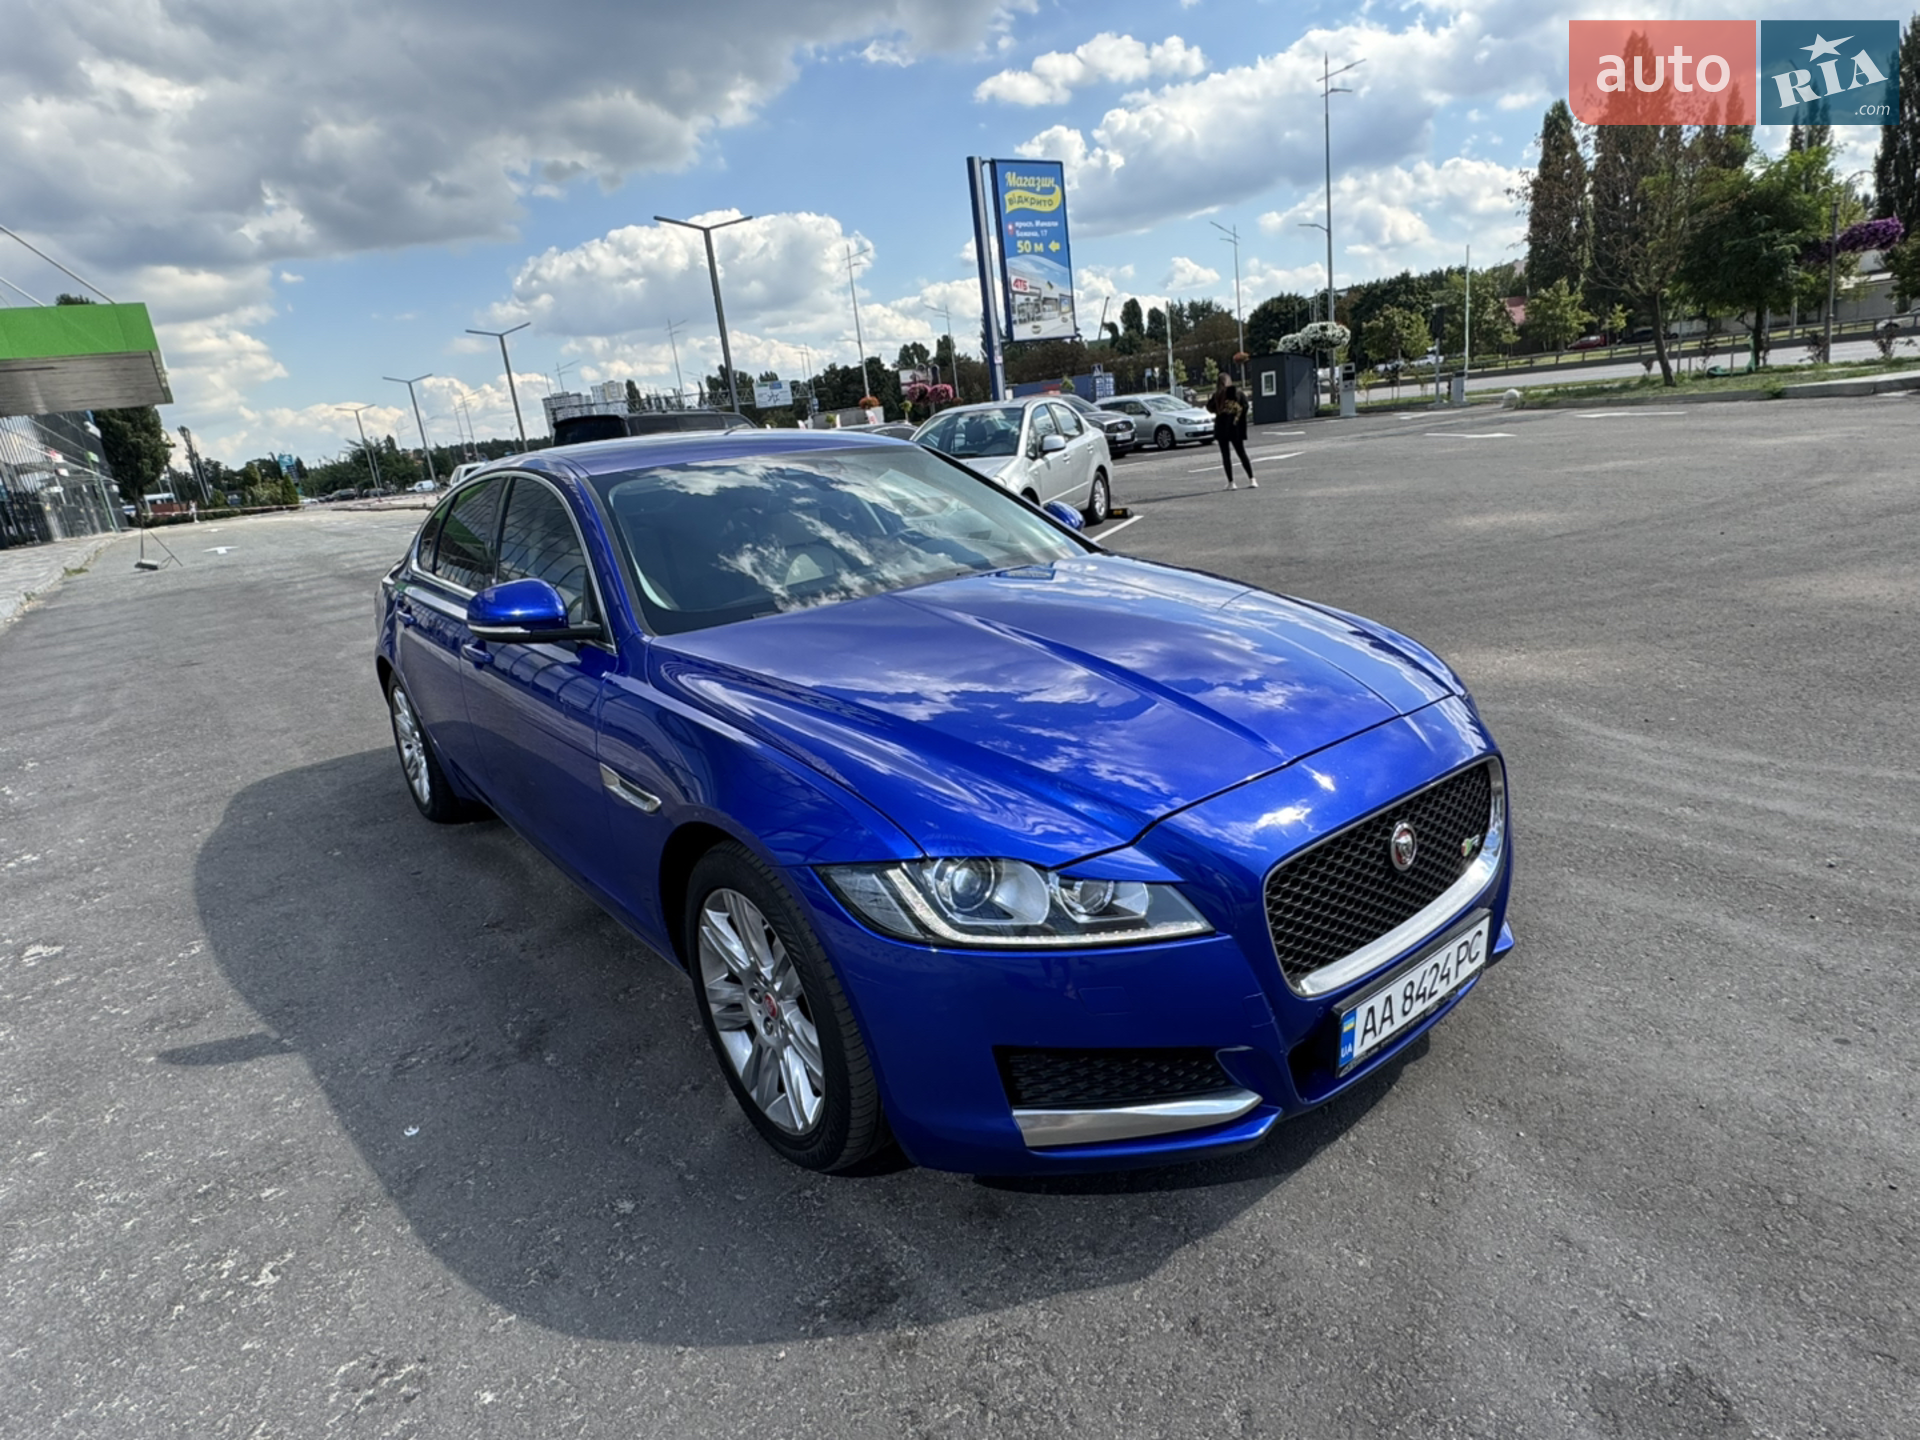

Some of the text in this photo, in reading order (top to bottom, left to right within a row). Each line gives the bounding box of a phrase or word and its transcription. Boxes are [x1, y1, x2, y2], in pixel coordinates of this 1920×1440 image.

[1005, 171, 1056, 192] Магазин
[1007, 193, 1054, 207] відкрито
[1016, 240, 1032, 254] 50
[1359, 994, 1395, 1047] AA
[1401, 952, 1451, 1017] 8424
[1455, 930, 1483, 979] PC
[1341, 1043, 1353, 1058] UA
